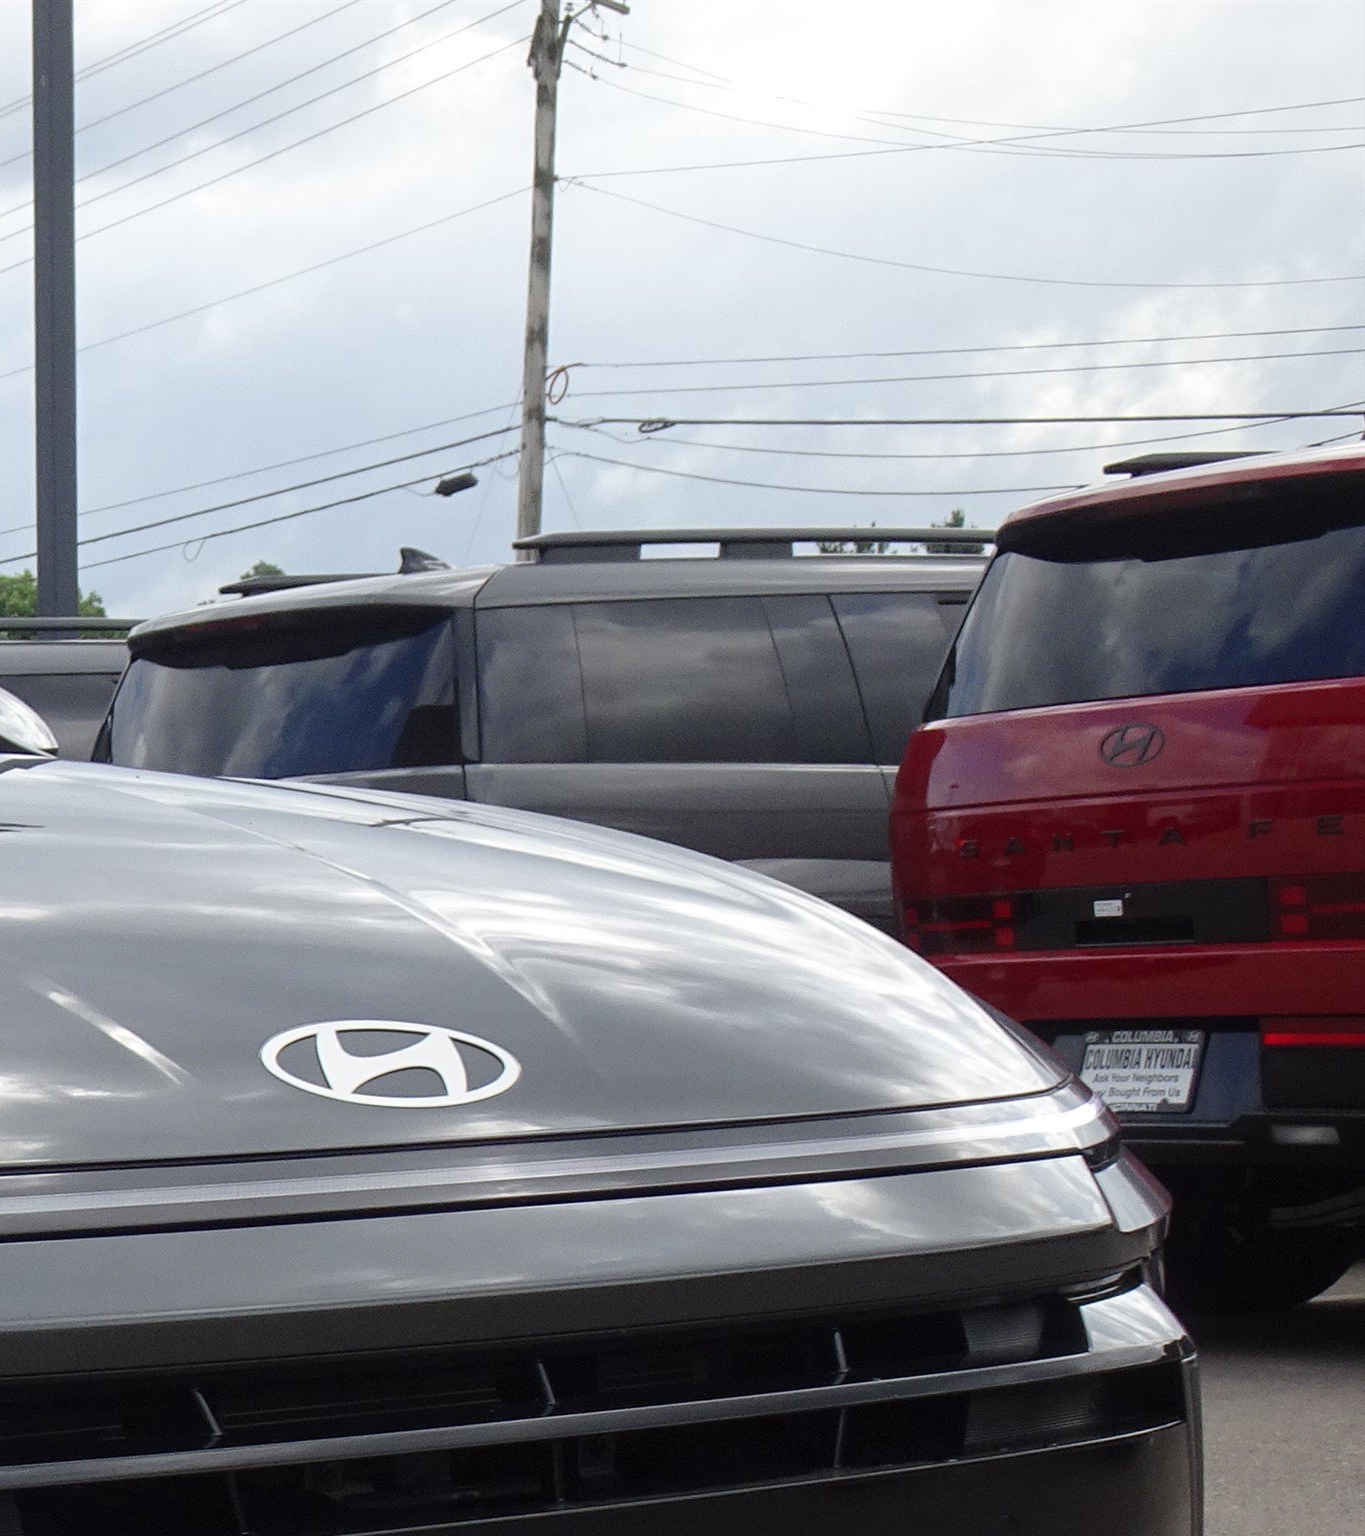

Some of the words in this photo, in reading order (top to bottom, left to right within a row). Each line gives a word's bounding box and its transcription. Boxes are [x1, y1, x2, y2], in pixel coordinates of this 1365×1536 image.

[960, 827, 1187, 859] SANTA
[1248, 815, 1345, 839] FE
[1111, 1031, 1174, 1043] COLUMBIA
[1085, 1048, 1142, 1070] COLUMBIA
[1093, 1073, 1109, 1083] Ask
[1111, 1073, 1130, 1083] Your
[1132, 1073, 1179, 1085] Neighbors
[1108, 1087, 1141, 1099] Bought
[1143, 1086, 1166, 1097] From
[1168, 1086, 1181, 1097] Us
